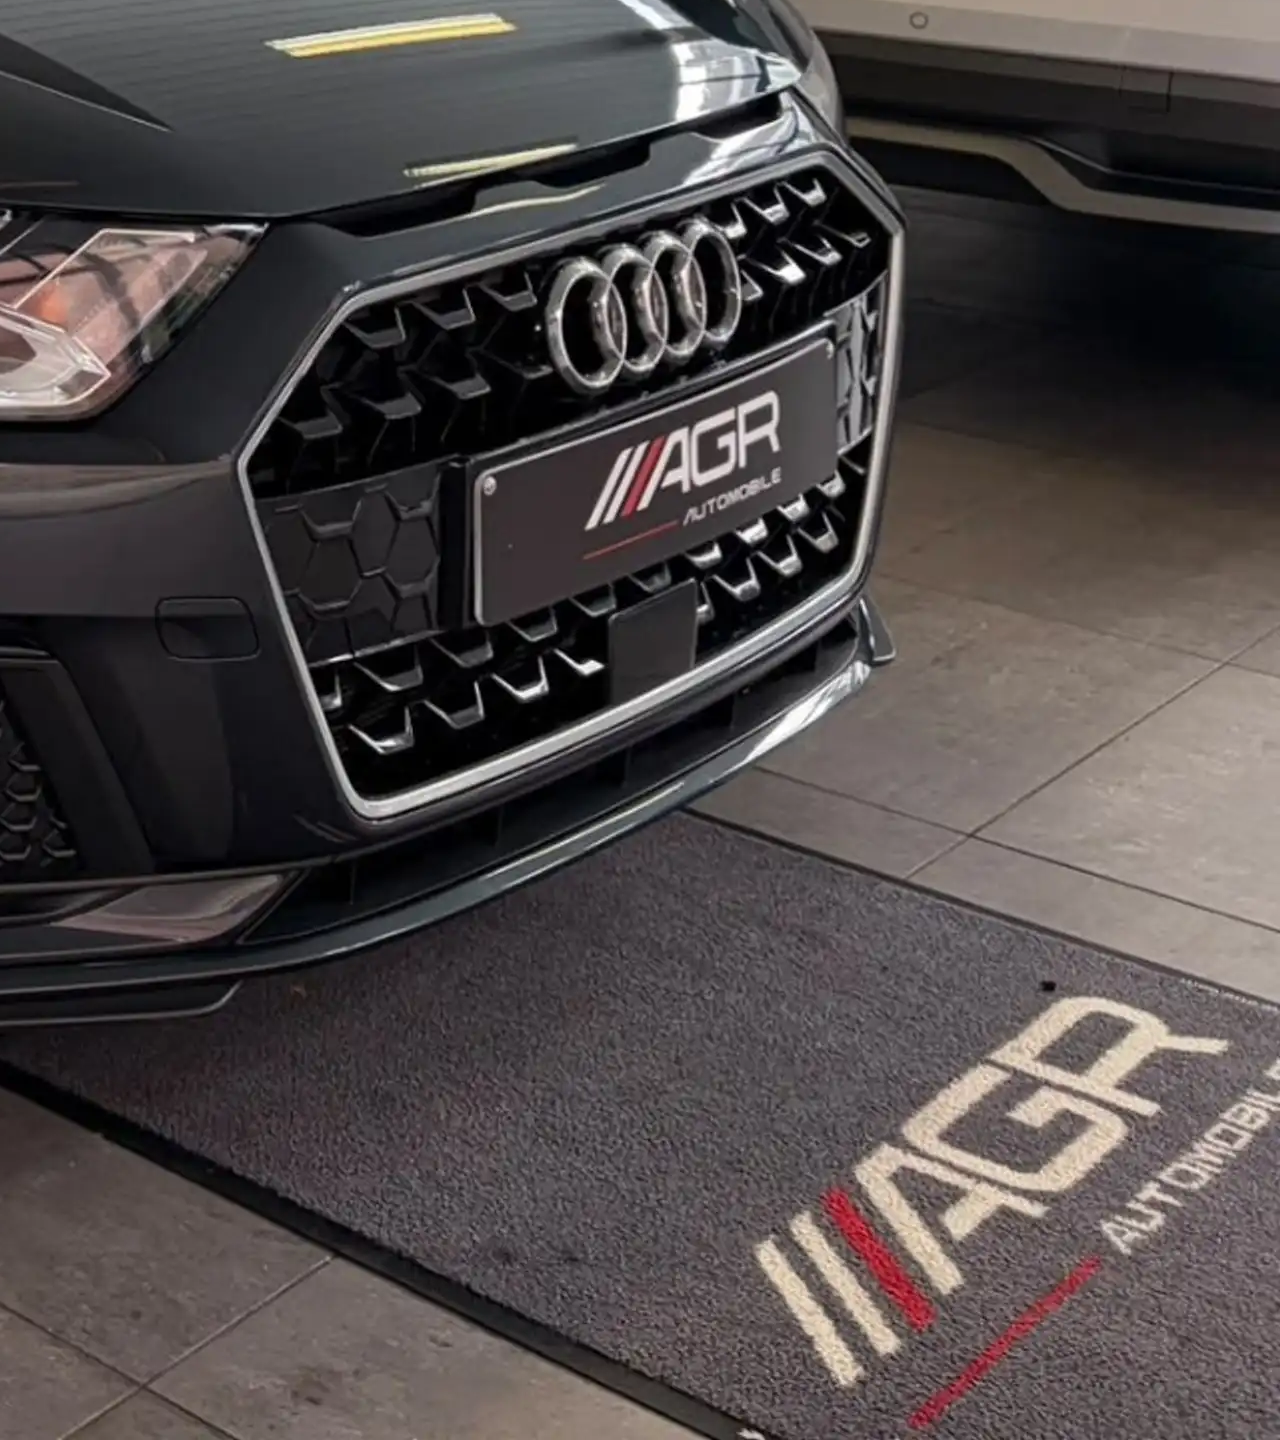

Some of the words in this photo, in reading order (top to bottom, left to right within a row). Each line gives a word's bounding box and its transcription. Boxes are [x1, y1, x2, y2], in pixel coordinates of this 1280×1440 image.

[637, 390, 781, 511] AGR
[683, 466, 782, 526] AUTOMOBILE
[854, 996, 1229, 1295] AGR
